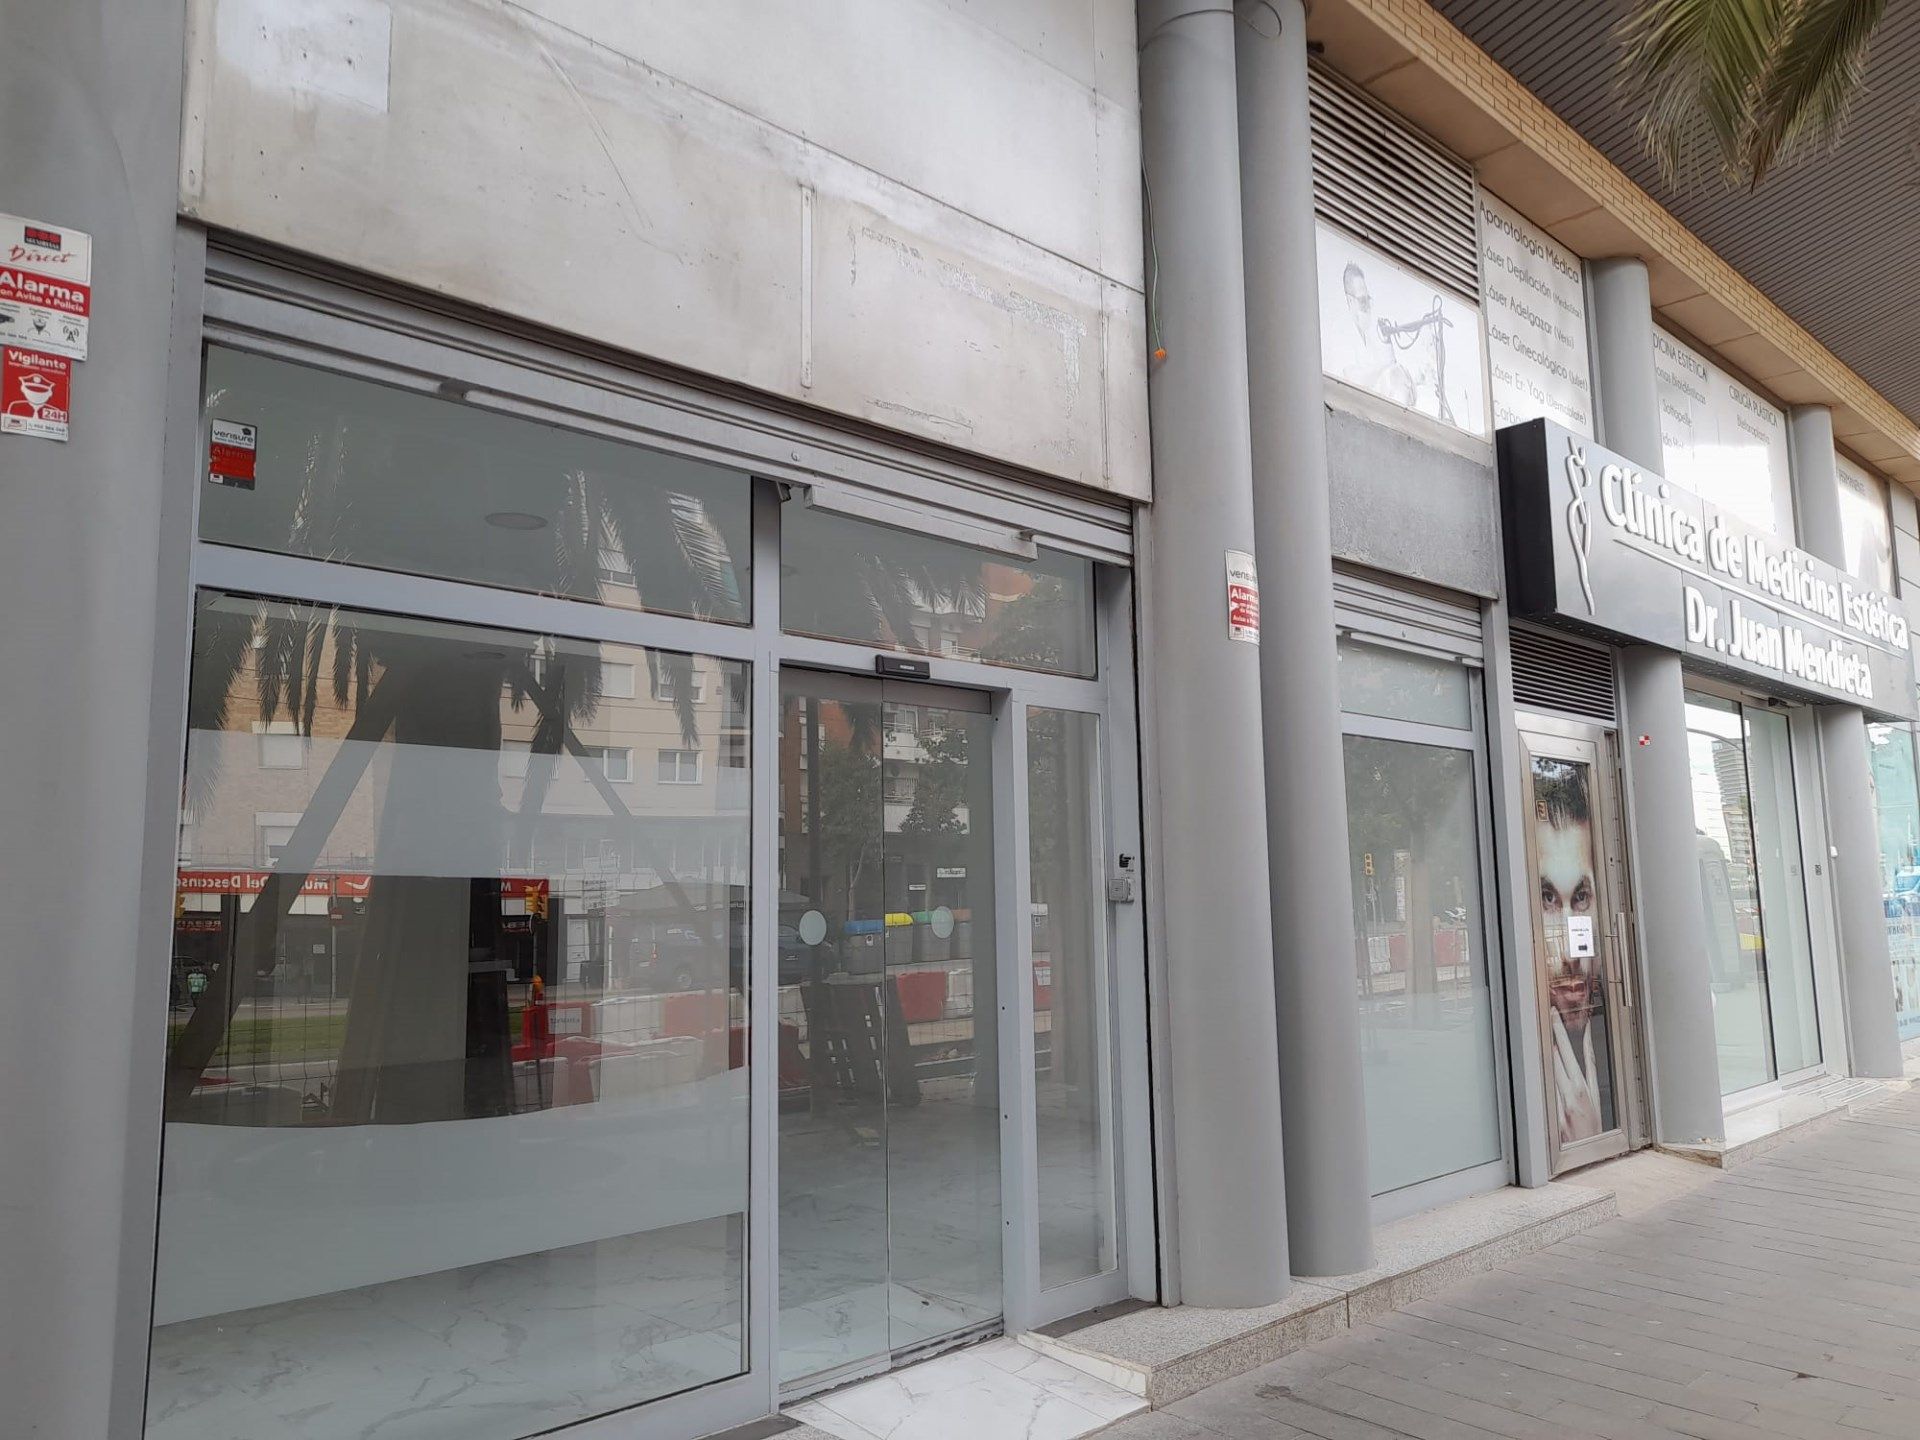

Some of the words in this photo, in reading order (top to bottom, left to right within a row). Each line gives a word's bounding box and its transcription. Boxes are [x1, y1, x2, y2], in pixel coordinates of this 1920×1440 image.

[1483, 245, 1505, 269] áser
[1506, 256, 1551, 299] Depilación
[1545, 245, 1580, 284] Médica
[0, 271, 84, 304] Alarma
[1510, 296, 1552, 335] Adelgazar
[8, 349, 67, 370] Vigilante
[1512, 334, 1568, 379] Ginecológico
[1652, 332, 1677, 360] DICINA
[44, 408, 67, 420] 24H
[1600, 464, 1705, 564] Clínica
[1708, 514, 1743, 579] de
[1745, 535, 1841, 622] Medicina
[1840, 582, 1909, 650] Estética
[1684, 585, 1726, 652] Dr.
[1728, 599, 1784, 670] Juan
[1782, 625, 1874, 699] Mendieta
